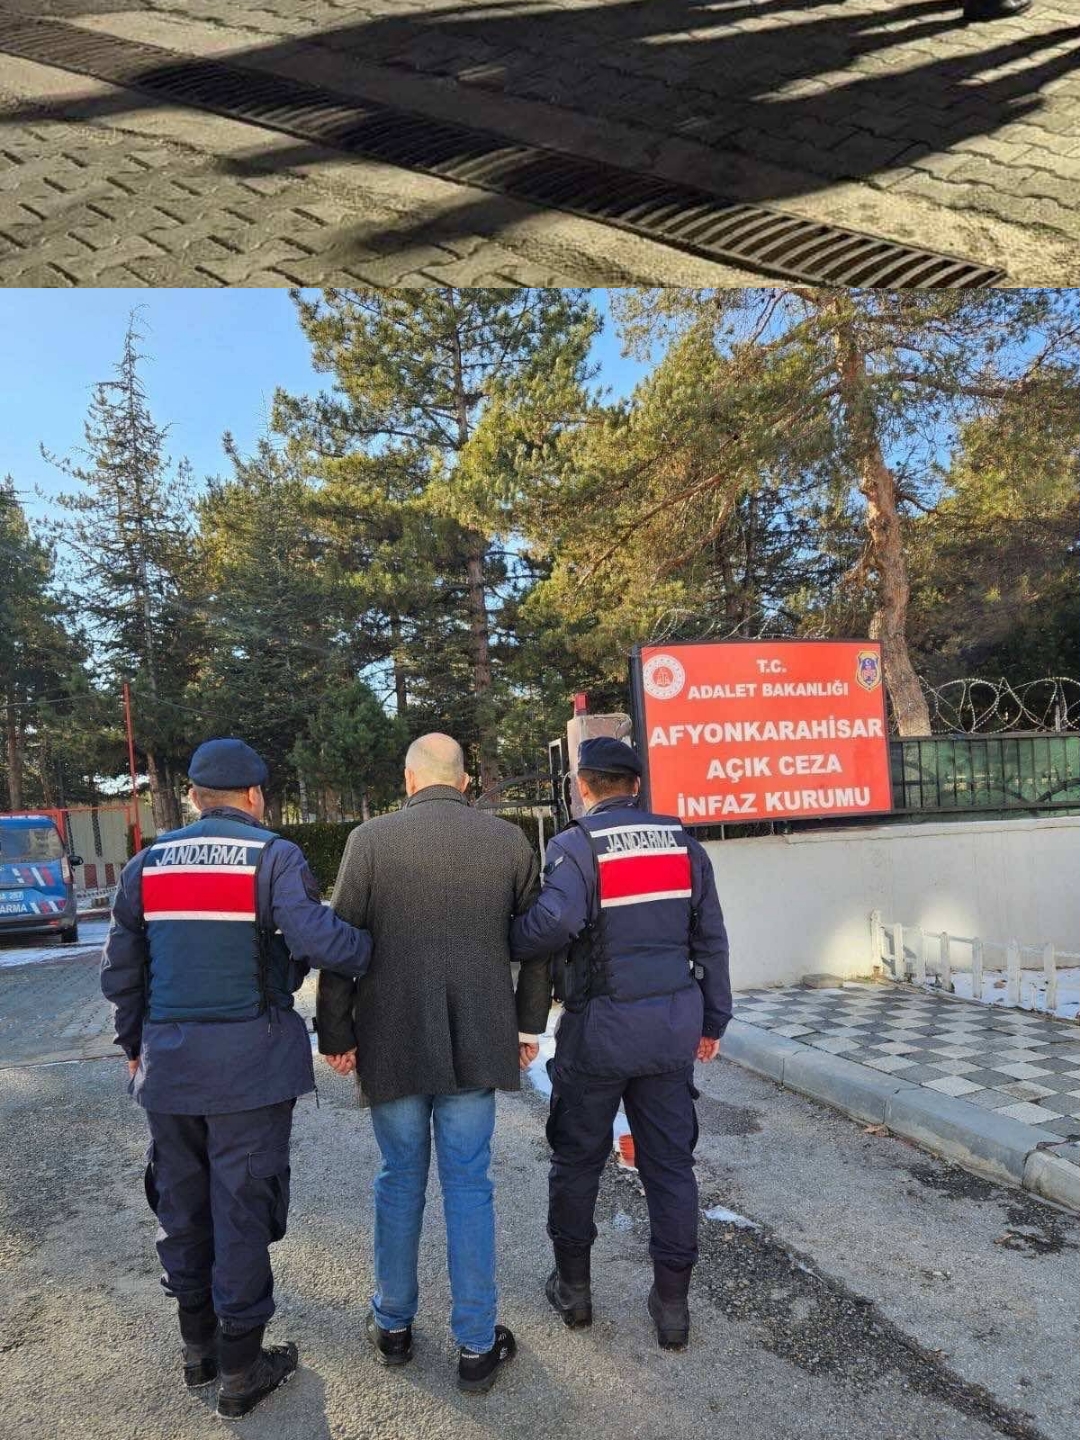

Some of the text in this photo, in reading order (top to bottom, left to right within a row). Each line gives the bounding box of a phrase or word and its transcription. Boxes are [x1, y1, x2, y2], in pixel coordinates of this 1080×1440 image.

[756, 659, 787, 673] T.C.
[687, 679, 849, 699] ADALET BAKANLIĞI
[649, 715, 884, 747] AFYONKARAHİSAR
[706, 754, 842, 783] AÇIK CEZA
[677, 787, 870, 817] İNFAZ KURUMU
[605, 830, 678, 852] JANDARMA
[155, 844, 247, 866] JANDARMA
